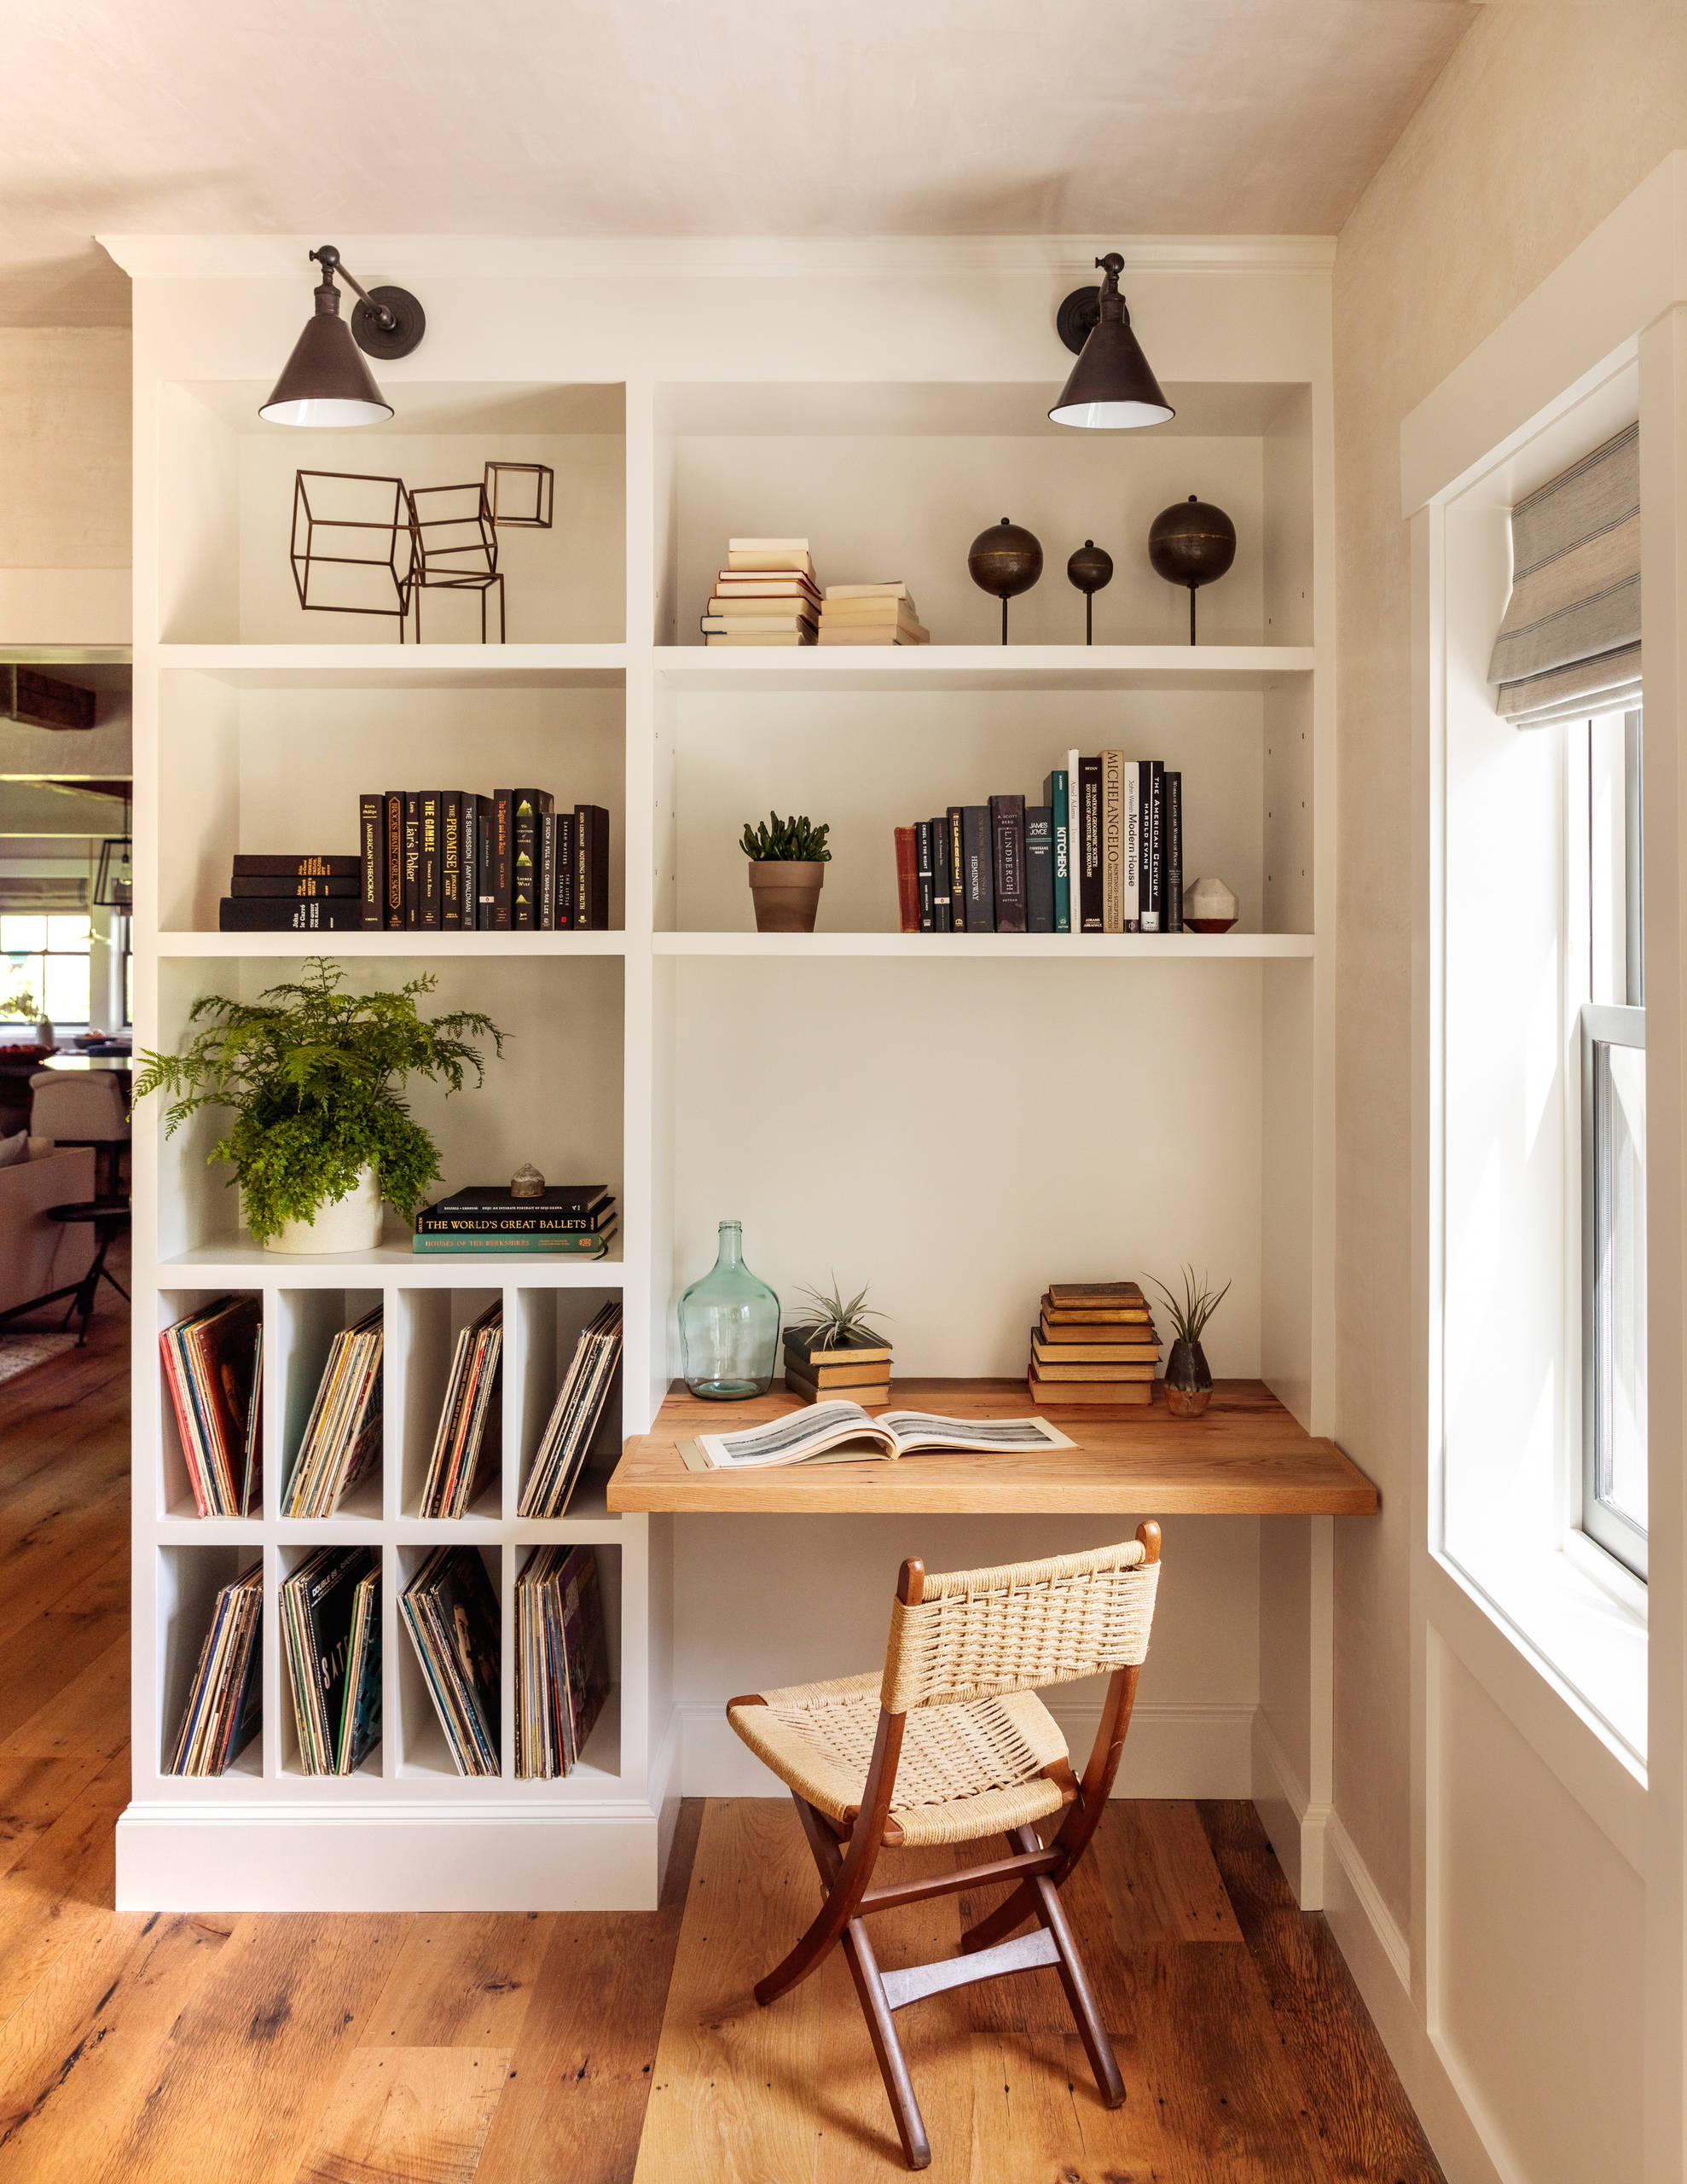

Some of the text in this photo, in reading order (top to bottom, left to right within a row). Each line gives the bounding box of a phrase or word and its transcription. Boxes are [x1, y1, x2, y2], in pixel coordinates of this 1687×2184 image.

[425, 800, 435, 852] THE GAMBLE
[1107, 752, 1119, 862] MICHELANGELO
[406, 821, 419, 882] Liar's Poker
[446, 818, 457, 868] PROMISE
[1057, 827, 1067, 877] KITCHENS
[1128, 814, 1137, 852] Modern
[1005, 831, 1013, 891] LINDBERGH
[1128, 855, 1137, 887] House
[426, 1219, 586, 1228] THE WORLD'S GREAT BALLETS
